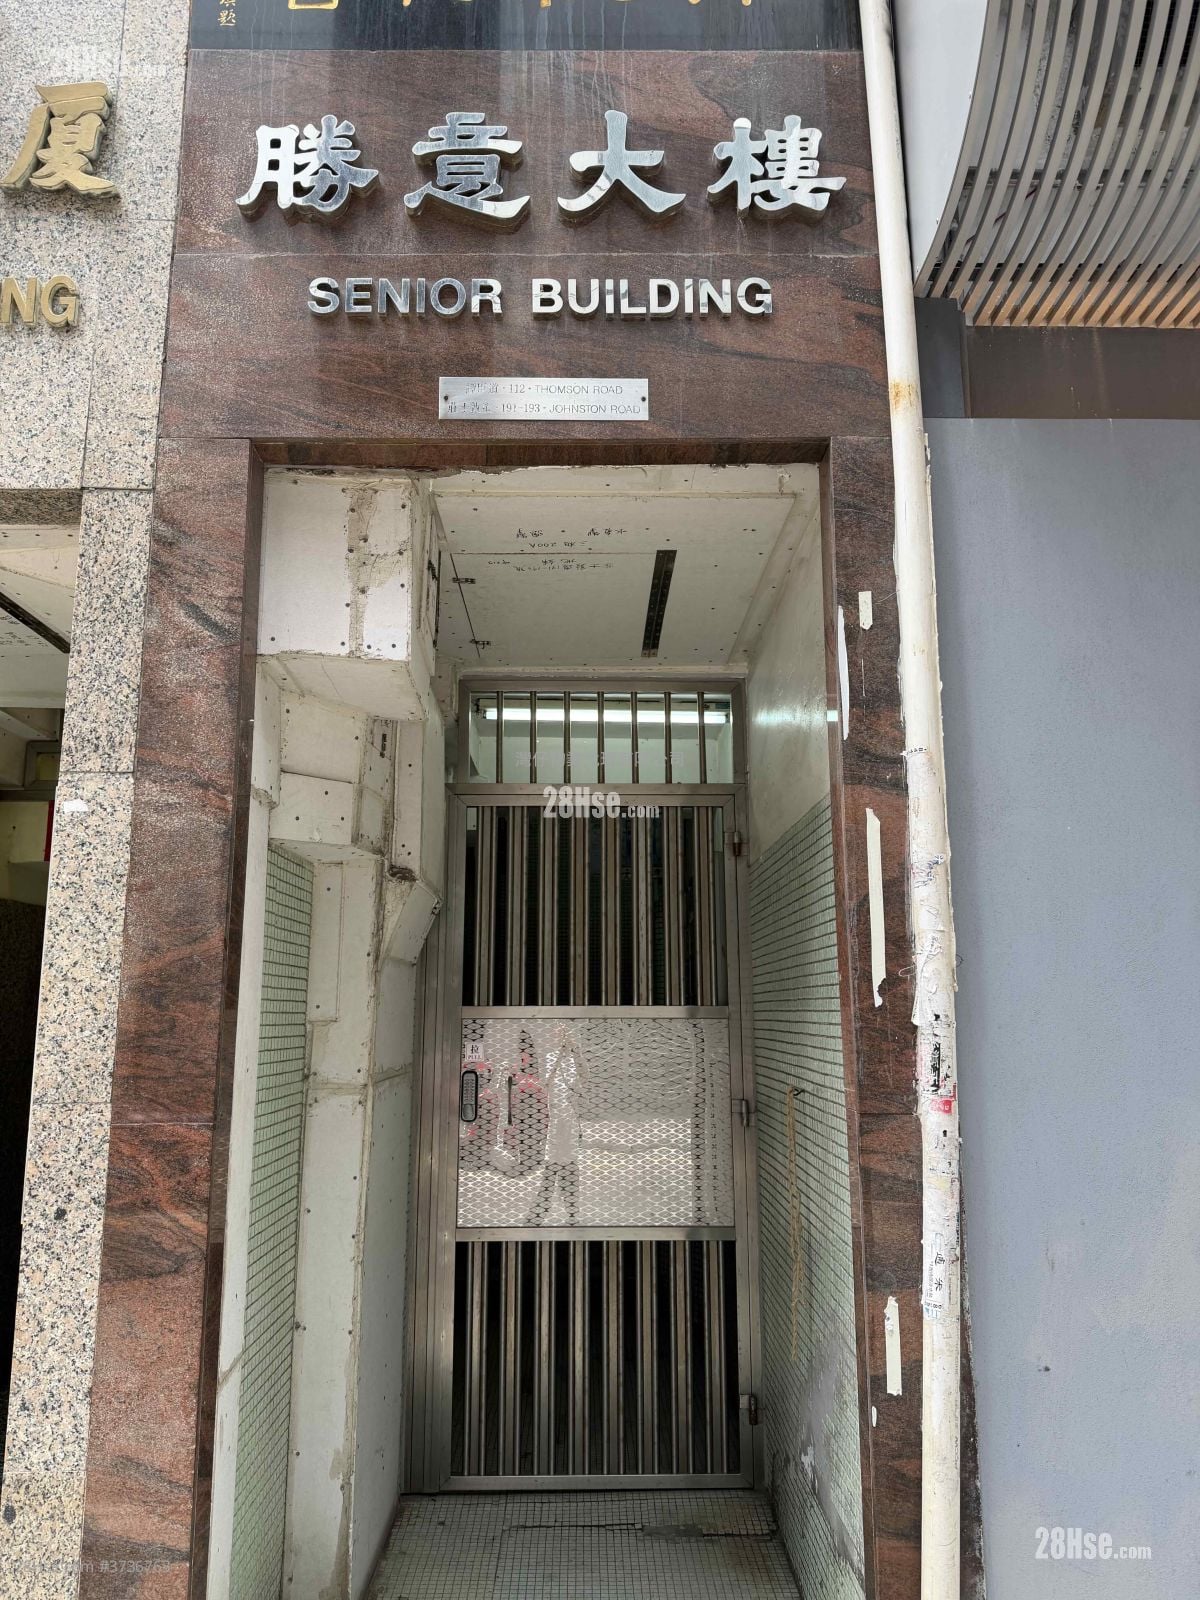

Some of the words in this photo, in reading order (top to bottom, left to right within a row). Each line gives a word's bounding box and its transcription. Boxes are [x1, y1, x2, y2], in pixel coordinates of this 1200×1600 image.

[235, 110, 846, 222] 勝意大樓
[307, 277, 503, 318] SENIOR
[532, 277, 774, 318] BUILDING
[509, 383, 526, 394] 112
[534, 384, 589, 395] THOMSON
[592, 384, 624, 395] ROAD
[549, 403, 607, 414] JOHNSTON
[610, 404, 641, 414] ROAD
